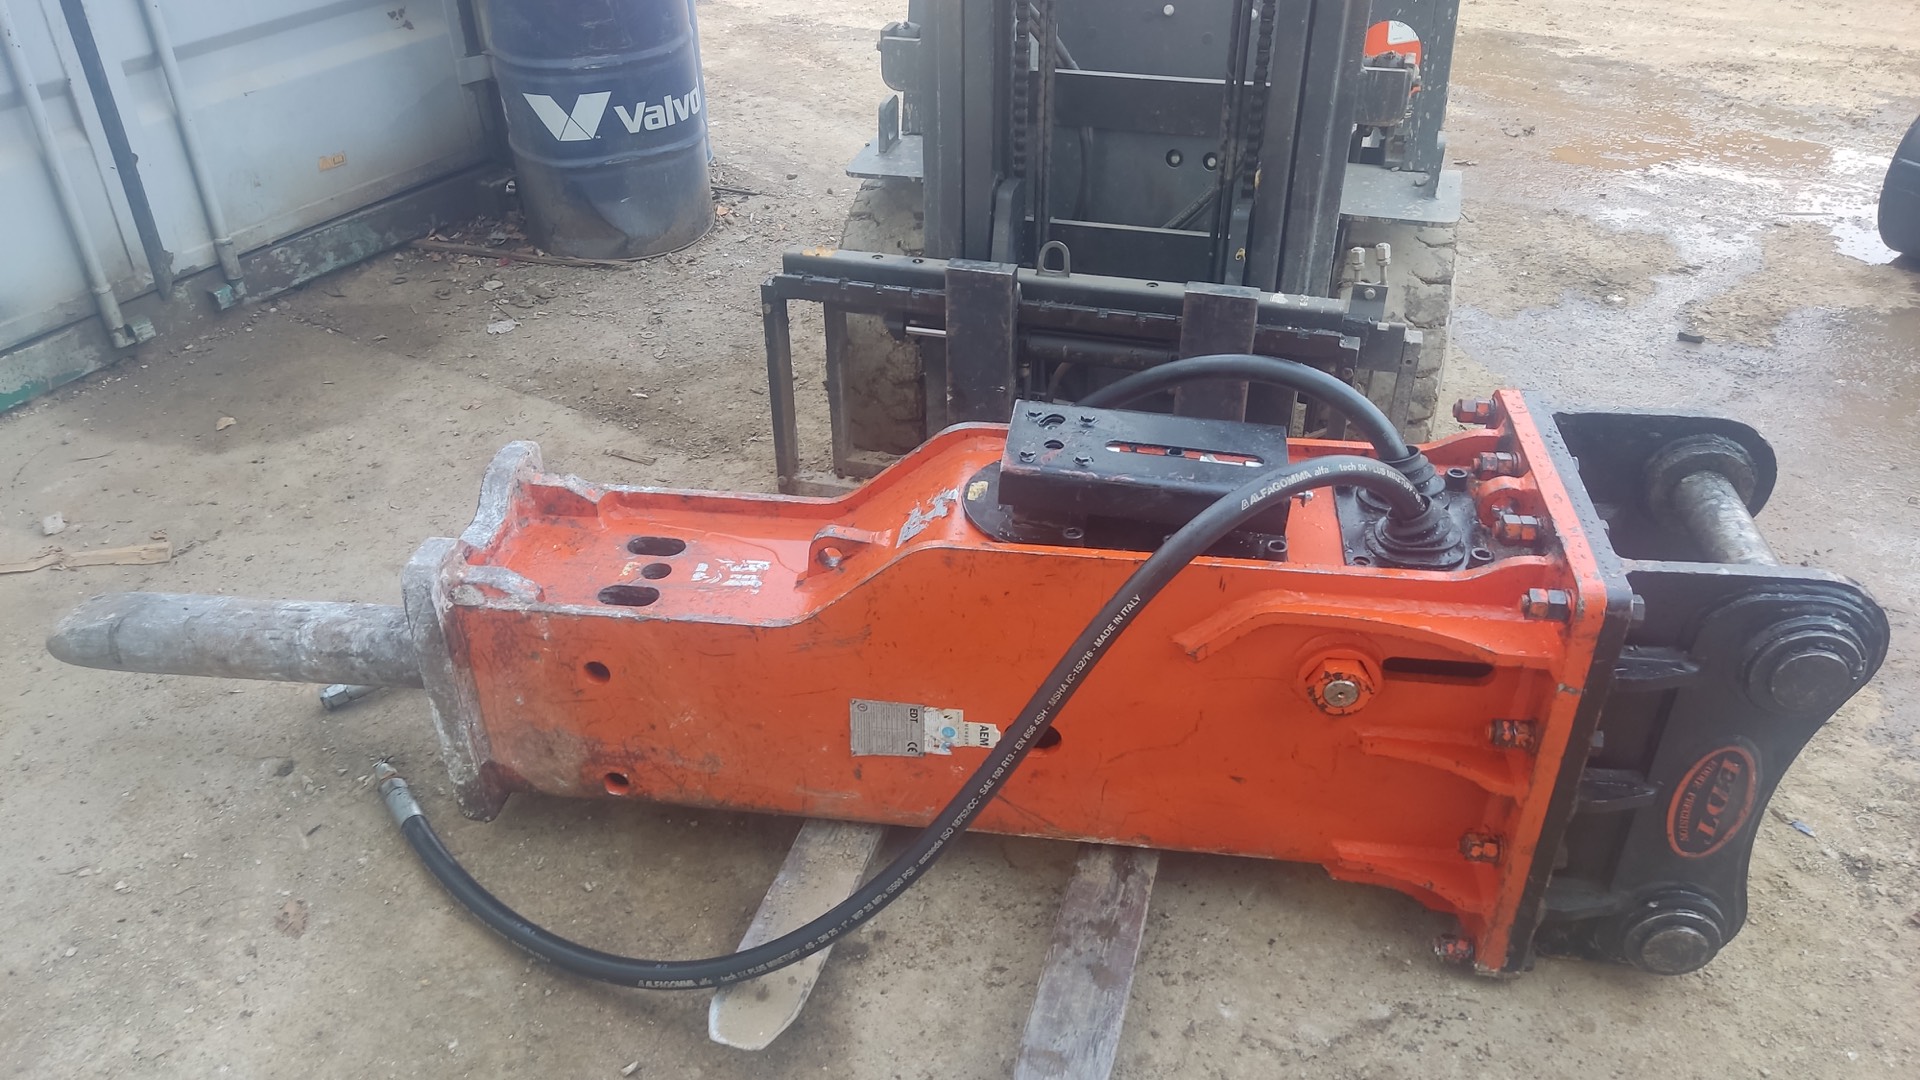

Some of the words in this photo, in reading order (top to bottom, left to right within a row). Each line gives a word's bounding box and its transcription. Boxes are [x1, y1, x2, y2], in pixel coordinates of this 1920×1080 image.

[613, 85, 701, 134] Valvo
[1250, 470, 1312, 506] ALFAGOMMA
[1314, 466, 1330, 477] alfa
[1338, 462, 1357, 472] tech
[909, 707, 919, 724] EDT
[940, 827, 955, 842] ISO
[979, 779, 995, 796] SAE
[991, 766, 1005, 781] 100
[1001, 753, 1016, 769] R13
[1014, 736, 1028, 751] EN
[1034, 708, 1049, 726] 4SH
[1048, 681, 1069, 708] MSHA
[1065, 649, 1094, 685] IC-152/16
[1093, 622, 1117, 649] MADE
[1112, 613, 1124, 626] IN
[1120, 593, 1142, 617] ITALY
[979, 724, 990, 747] AEM
